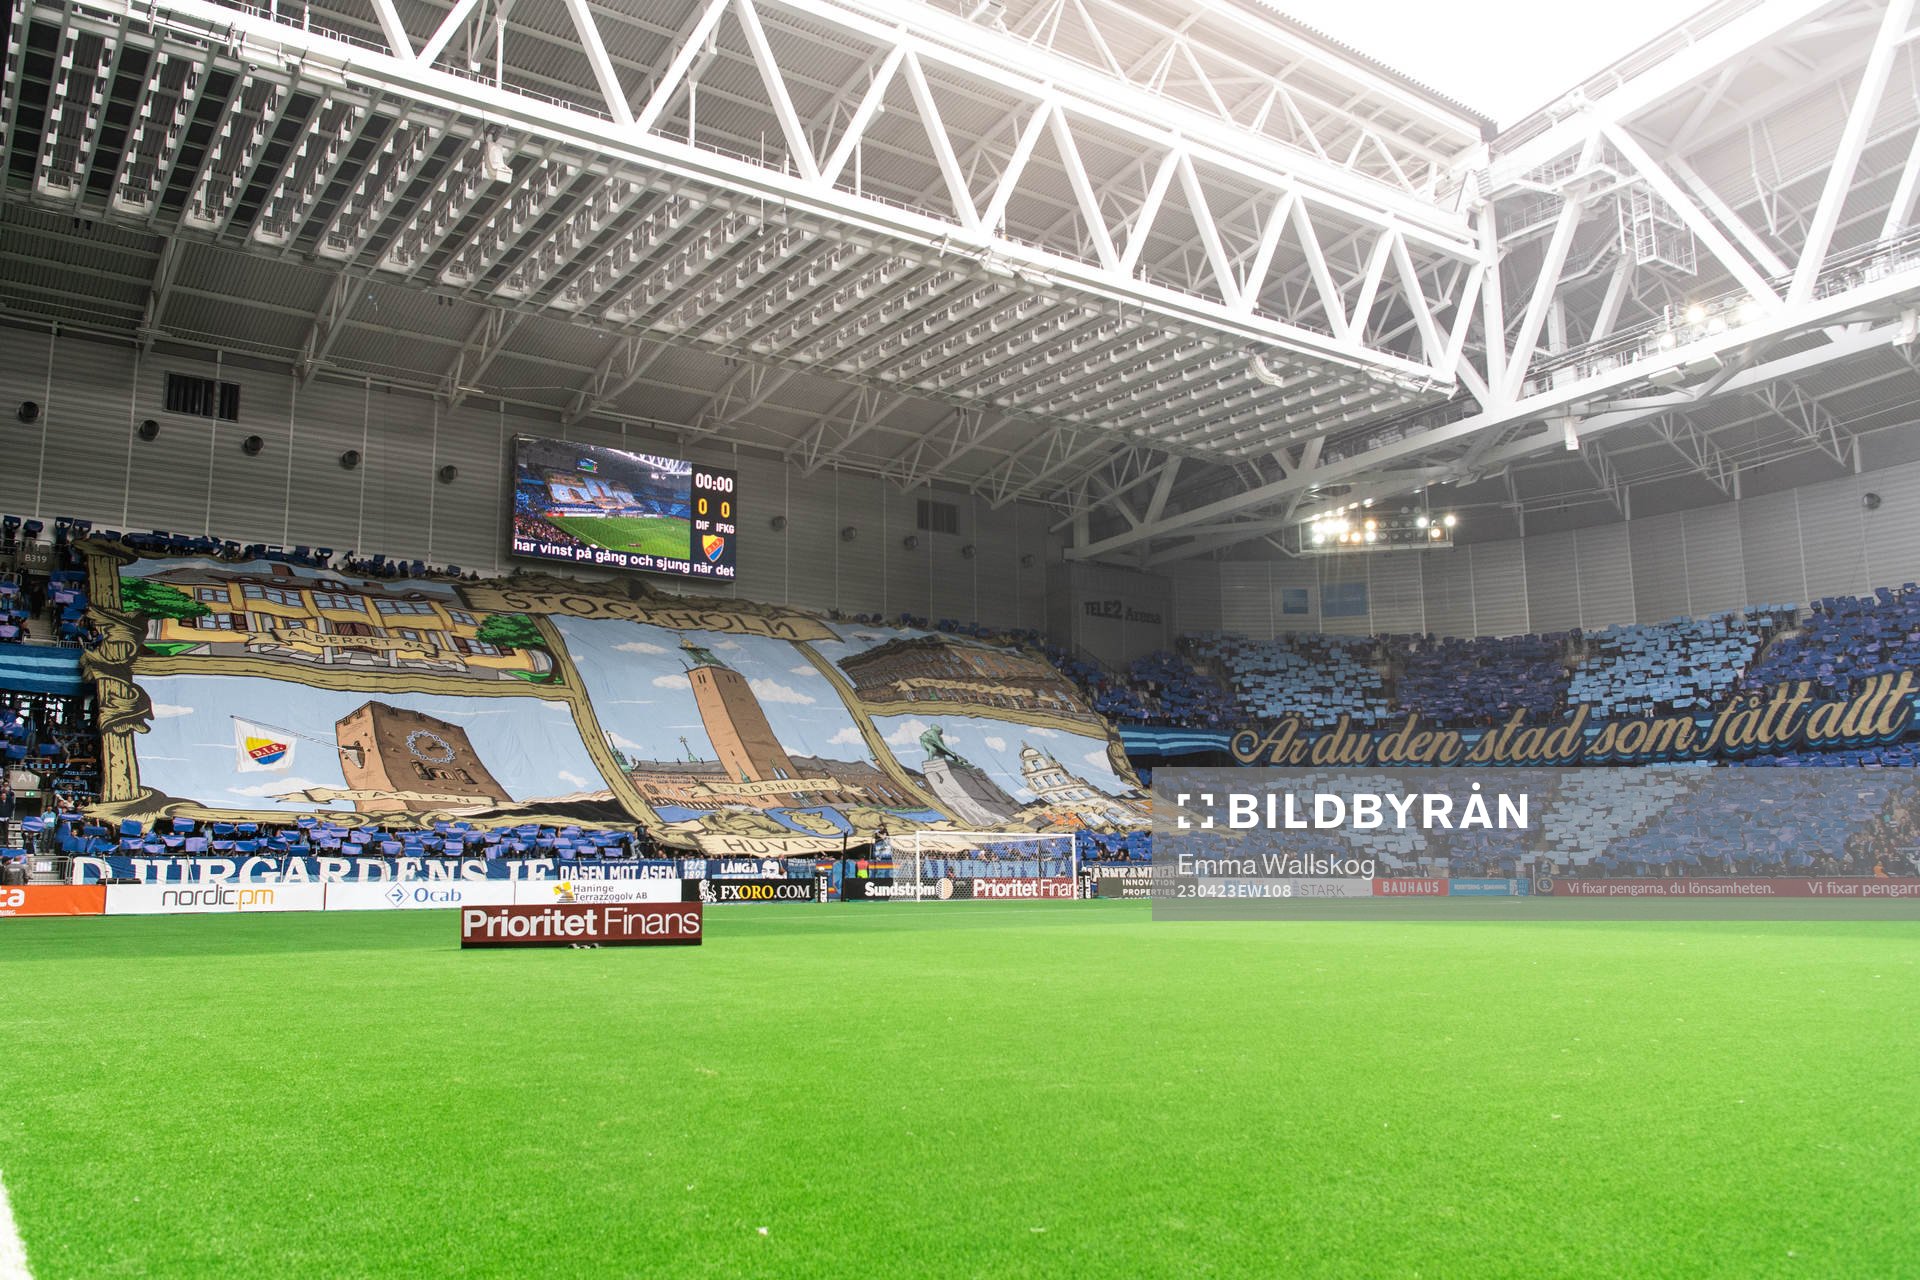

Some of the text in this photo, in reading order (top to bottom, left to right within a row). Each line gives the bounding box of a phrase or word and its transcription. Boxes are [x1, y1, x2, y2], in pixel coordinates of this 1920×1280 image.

[695, 472, 733, 493] 00:00
[698, 497, 730, 518] 0 0
[695, 519, 735, 534] DIF IFKG
[513, 538, 734, 577] har vinst på gång och sjung när det
[1084, 600, 1123, 619] TELE2
[287, 630, 392, 647] ALBERGET
[1230, 671, 1919, 765] Är du den stad som fått allt
[506, 858, 554, 881] IF
[720, 860, 758, 874] LÅNGA
[573, 884, 614, 893] Haninge
[820, 876, 828, 902] SELECT
[973, 878, 1079, 897] Prioritet Finan
[1122, 879, 1175, 887] INNOVATION
[1300, 884, 1345, 896] STARK
[1382, 881, 1439, 893] BAUHAUS
[1567, 882, 1775, 896] Vi fixar pengarna, du lönsamheten.
[1807, 881, 1823, 894] Vi
[1826, 881, 1859, 894] fixar
[413, 887, 462, 902] Ocab
[575, 892, 633, 902] Terrazzogolv
[636, 891, 648, 899] AB
[720, 884, 811, 900] FXORO.COM
[1122, 888, 1176, 896] PROPERTIES
[463, 907, 700, 938] Prioritet Finans
